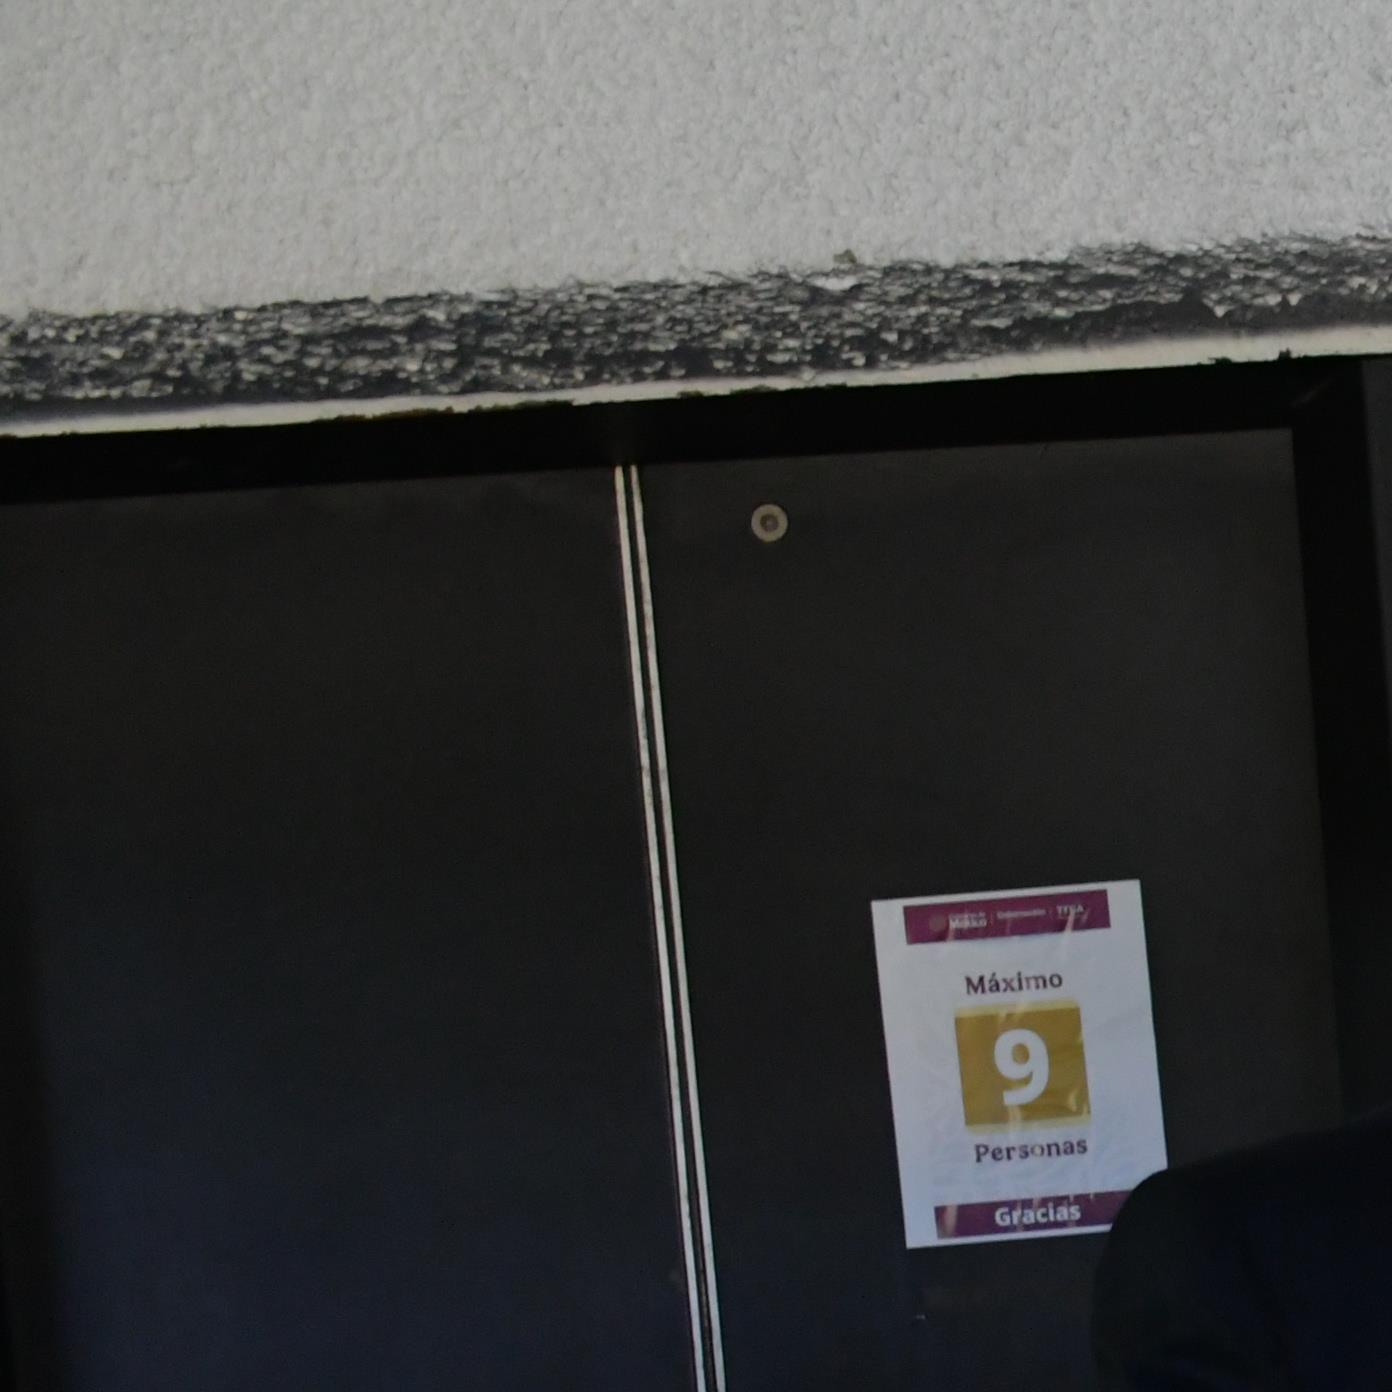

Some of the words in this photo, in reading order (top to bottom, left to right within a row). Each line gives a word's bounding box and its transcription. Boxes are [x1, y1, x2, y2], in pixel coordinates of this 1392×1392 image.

[964, 971, 1063, 996] Máximo
[993, 1028, 1050, 1106] 9
[974, 1138, 1089, 1164] Personas
[994, 1202, 1082, 1228] Gracias
